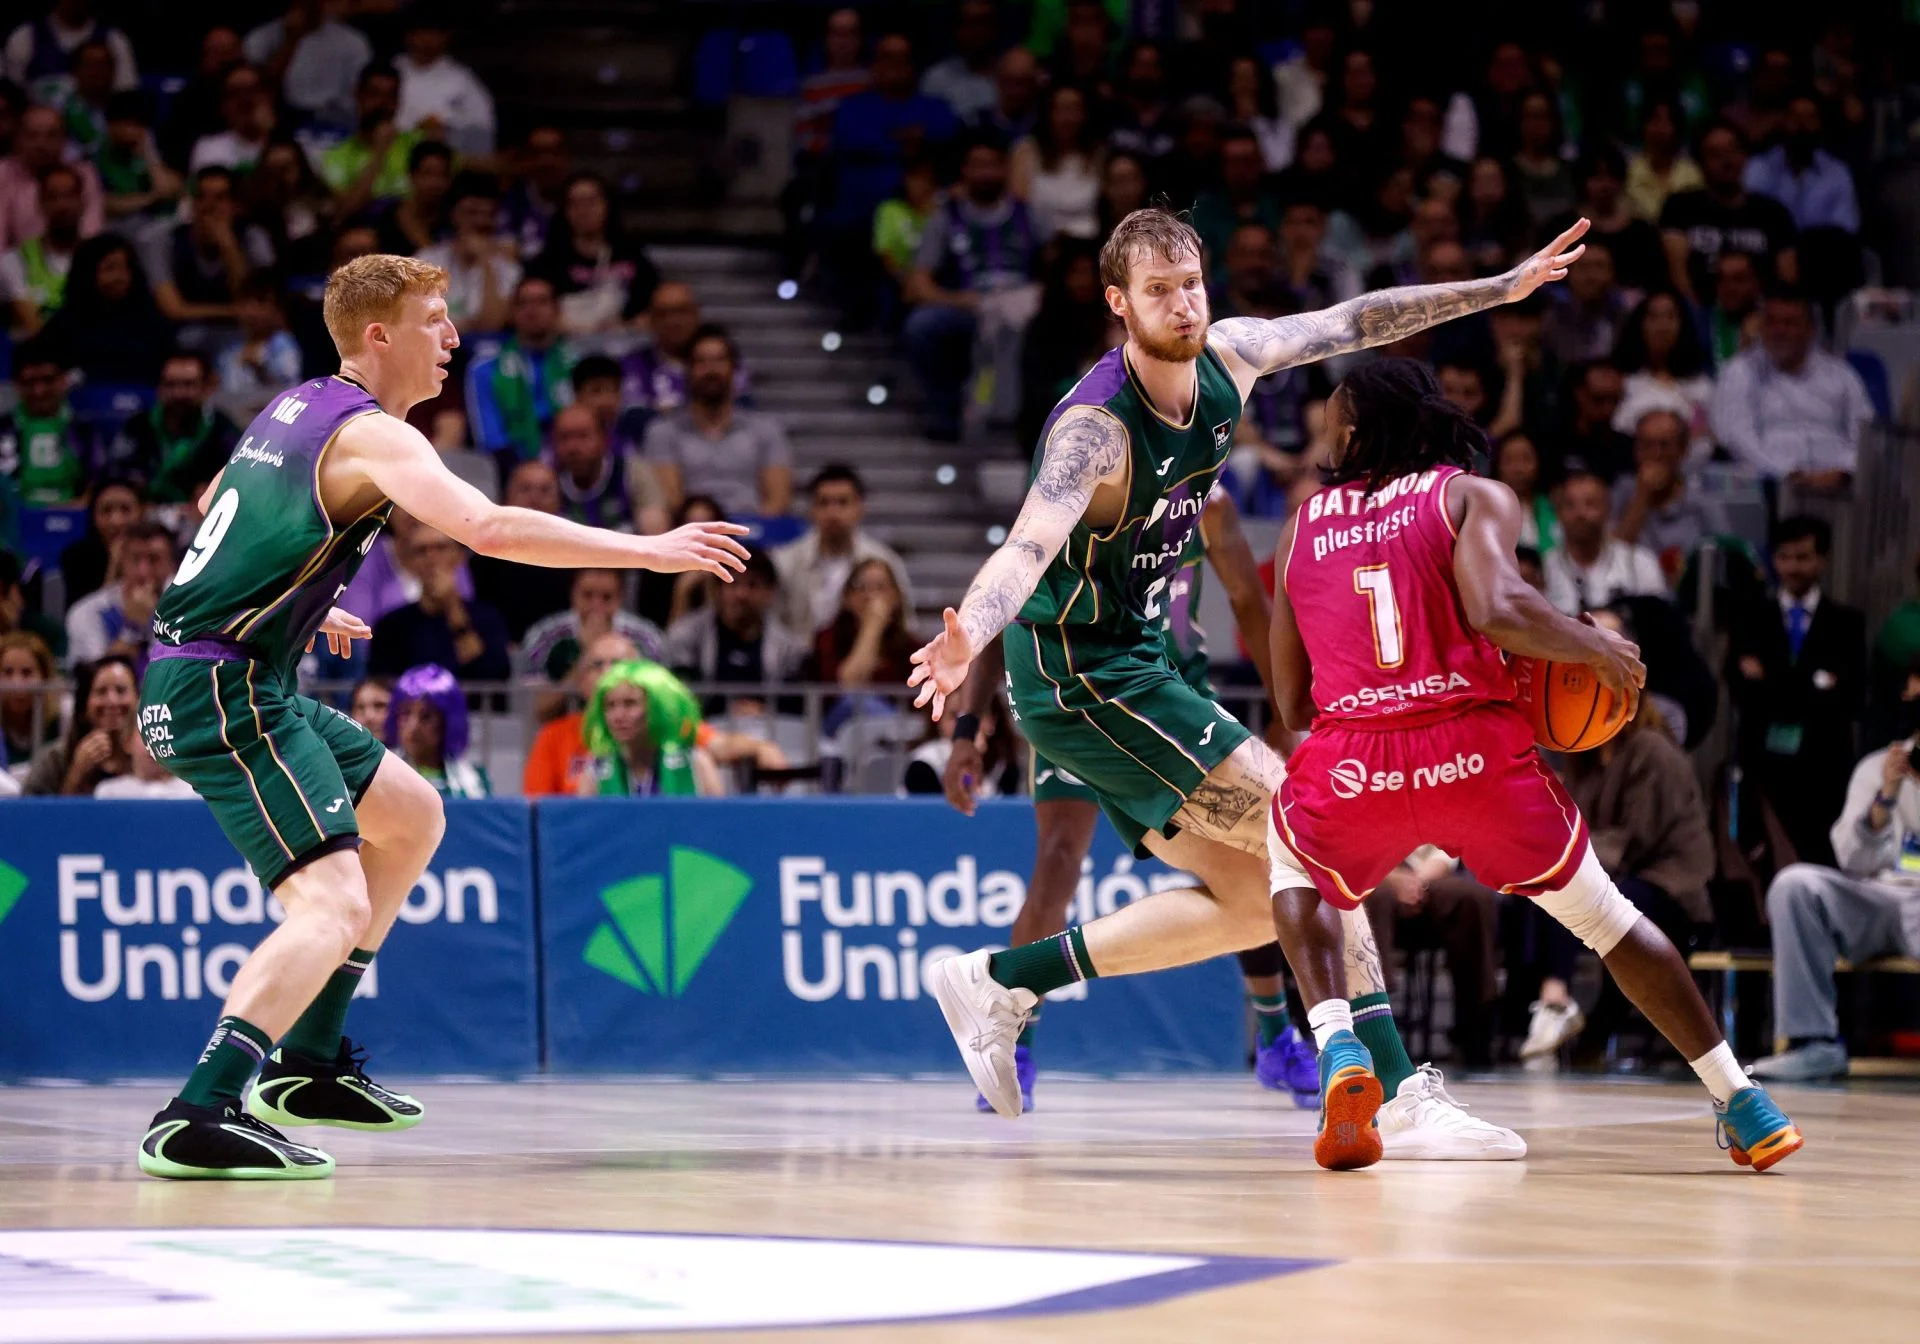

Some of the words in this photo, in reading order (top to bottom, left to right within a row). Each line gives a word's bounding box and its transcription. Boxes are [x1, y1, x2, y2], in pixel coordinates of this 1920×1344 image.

[172, 487, 240, 586] 9
[1353, 561, 1404, 670] 1
[57, 854, 498, 925] Fundon
[779, 855, 1200, 927] Fundaió
